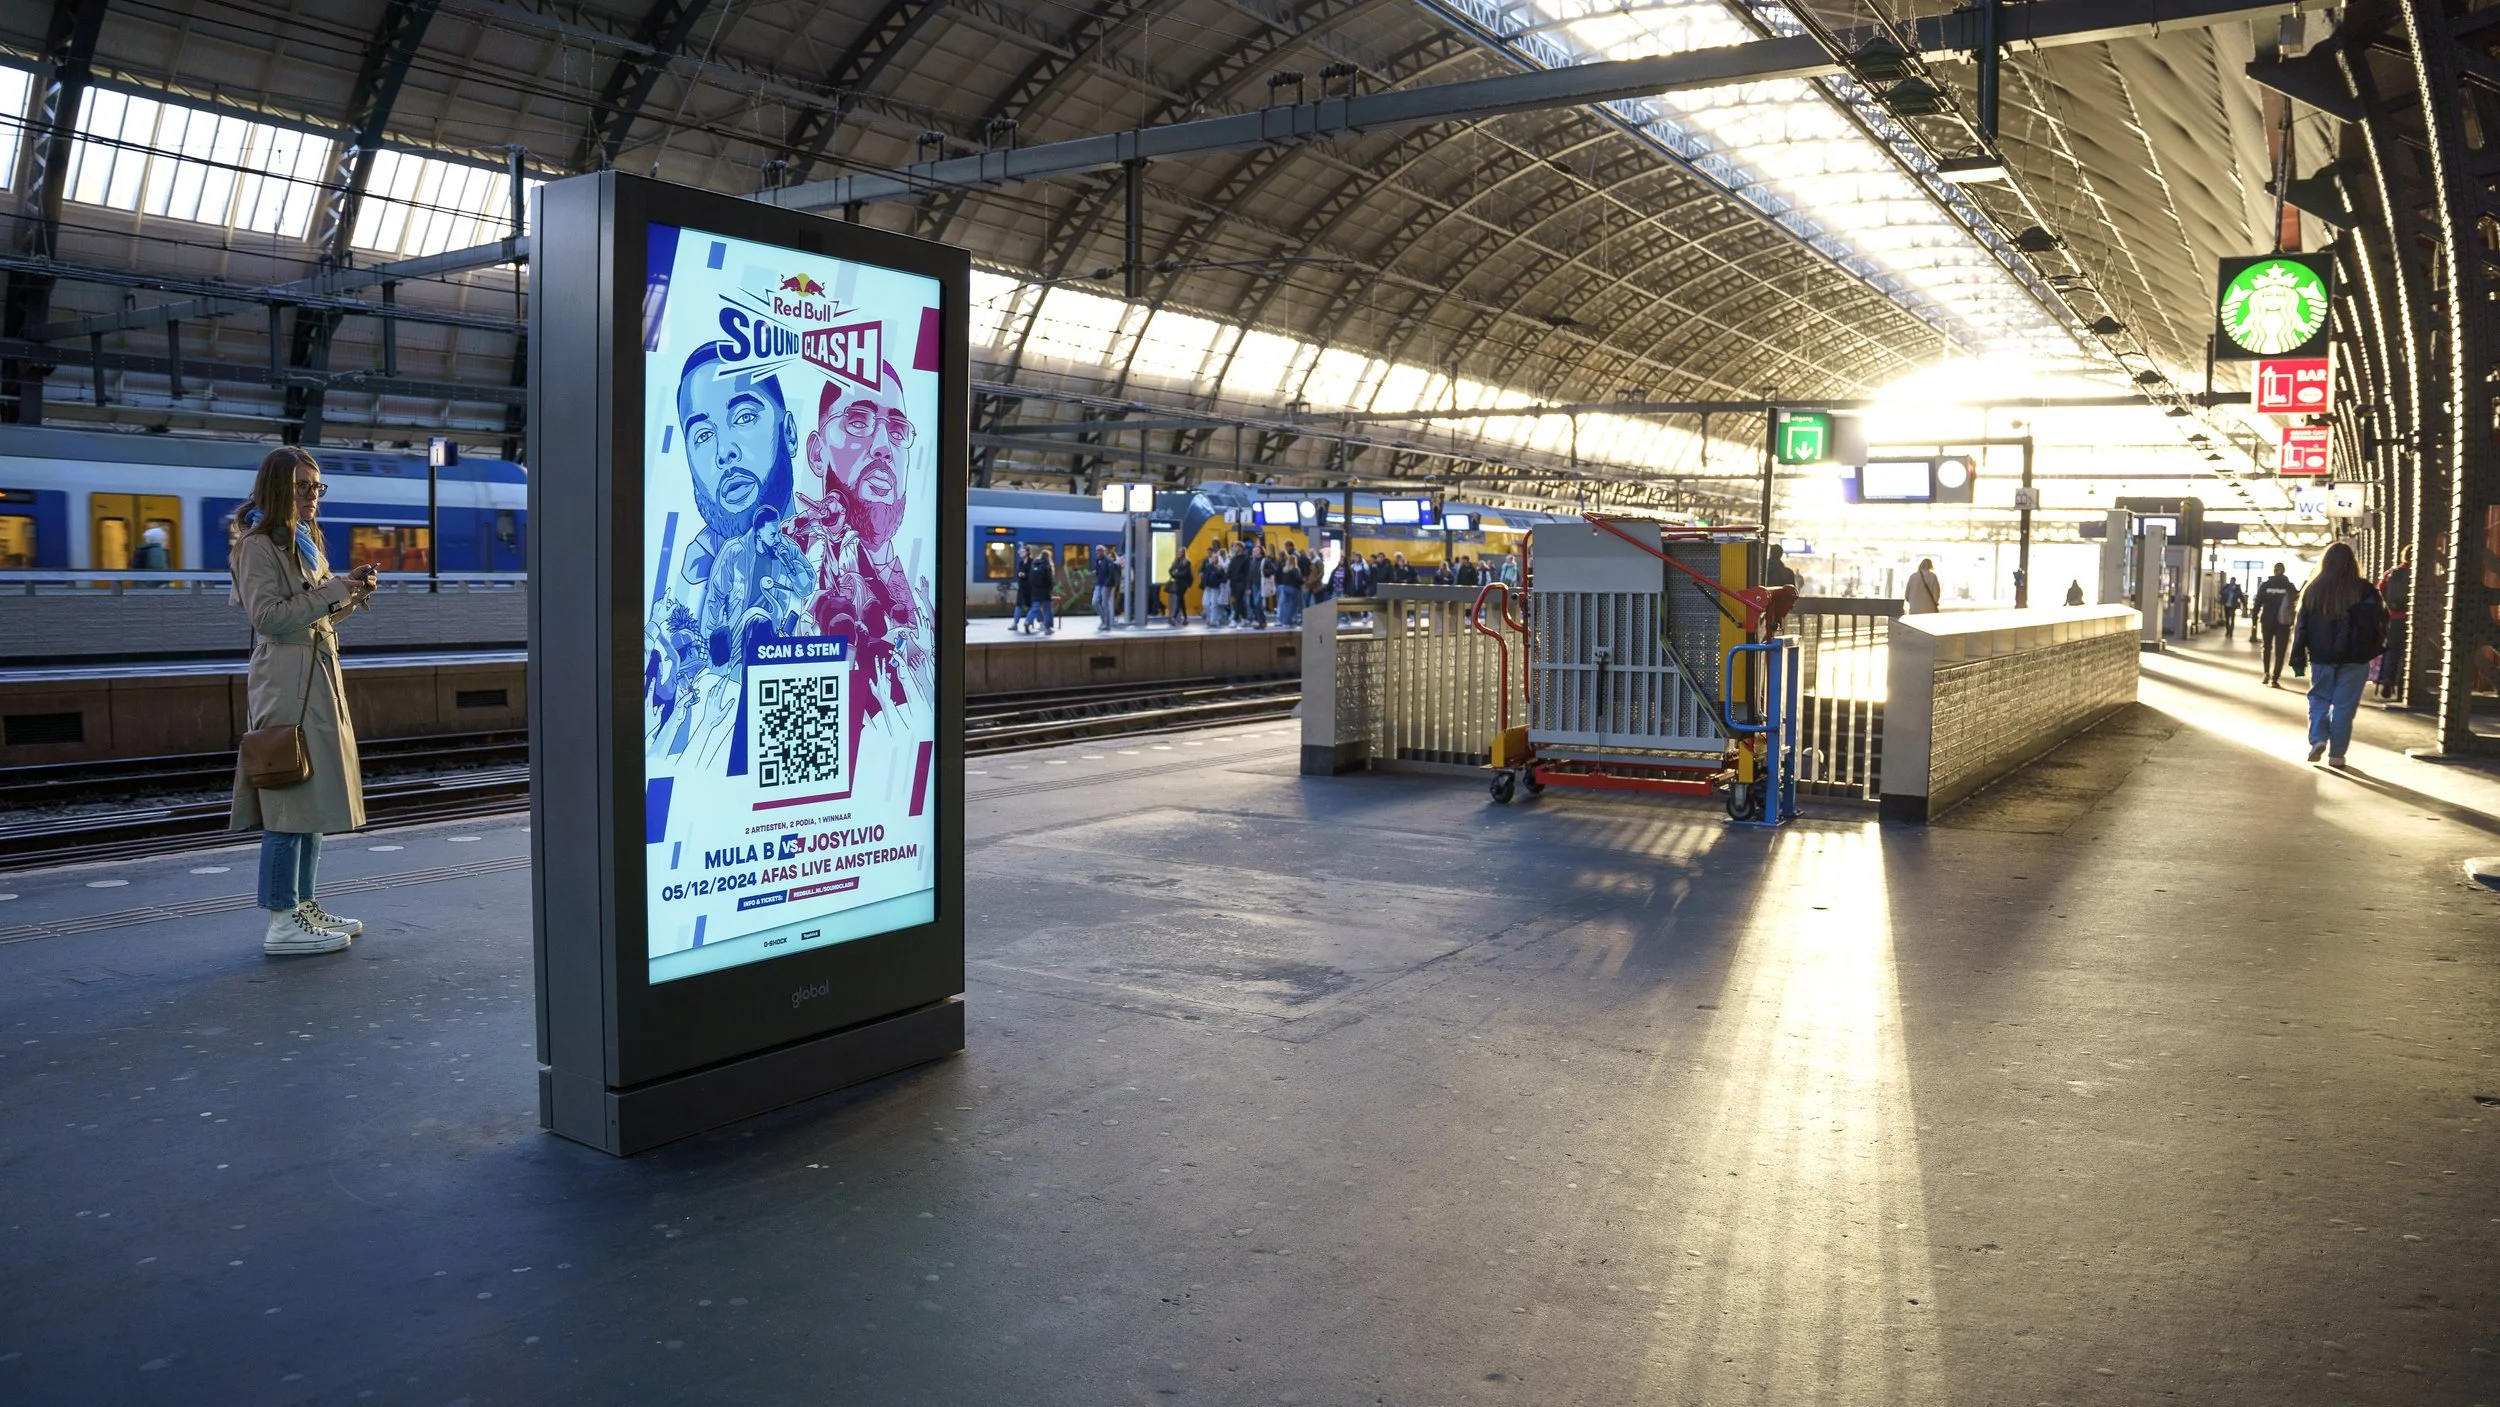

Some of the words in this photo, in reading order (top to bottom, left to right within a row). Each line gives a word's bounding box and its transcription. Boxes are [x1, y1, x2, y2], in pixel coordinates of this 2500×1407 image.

[774, 296, 801, 318] Red
[804, 301, 831, 322] Bull
[718, 307, 800, 362] SOUND
[804, 328, 878, 384] CLASH
[2296, 368, 2327, 382] BAR
[2299, 502, 2325, 514] WC
[757, 644, 792, 660] SCAN
[795, 643, 805, 658] &
[806, 642, 840, 657] STEM
[744, 827, 750, 835] 2
[751, 822, 788, 834] ARTIESTEN,
[789, 820, 795, 828] 2
[795, 817, 817, 828] PODIA,
[818, 816, 822, 824] 1
[822, 812, 852, 824] WINNAAR
[704, 846, 759, 869] MULA
[763, 842, 775, 859] B
[807, 824, 885, 853] JOSYLVIO
[661, 871, 757, 902] 05/12/2024
[760, 864, 798, 884] AFAS
[801, 858, 831, 878] LIVE
[834, 843, 918, 869] AMSTERDAM
[743, 900, 756, 908] INFO
[761, 894, 784, 904] TICKETS:
[763, 936, 788, 948] G-SHOCK
[791, 978, 829, 1009] global
